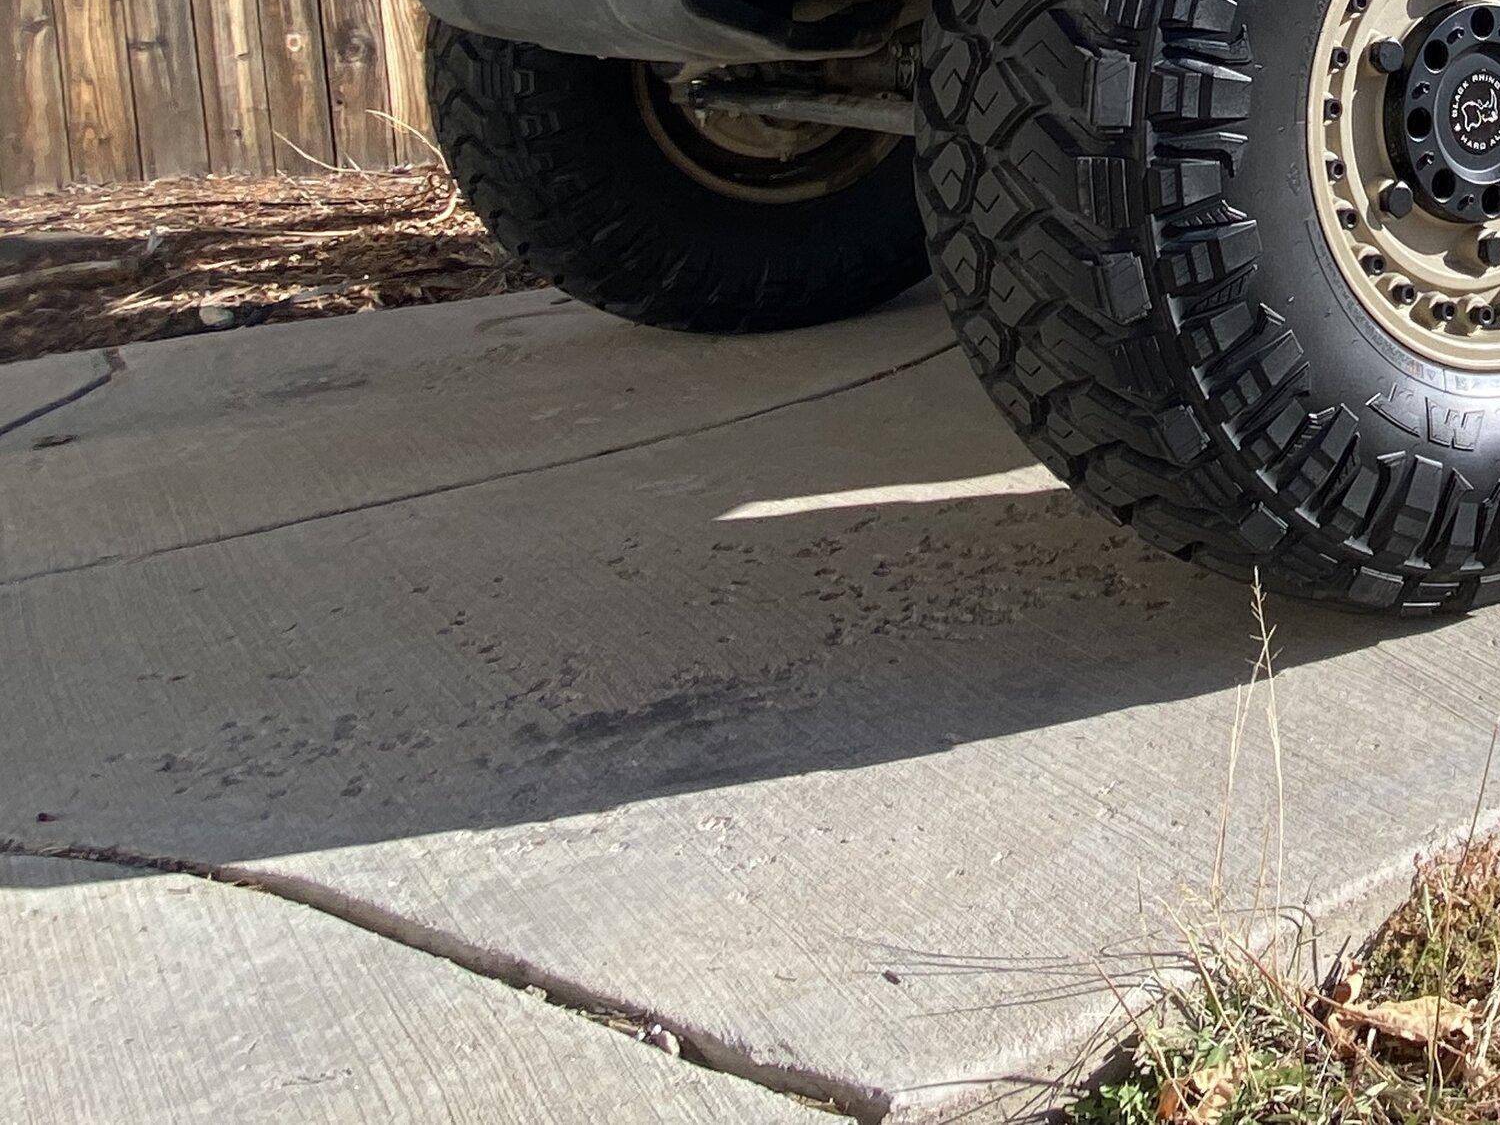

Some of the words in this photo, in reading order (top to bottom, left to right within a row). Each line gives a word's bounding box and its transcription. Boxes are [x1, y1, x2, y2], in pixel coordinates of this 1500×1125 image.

[1451, 80, 1469, 118] BLACK
[1471, 74, 1500, 90] RHINO
[1460, 134, 1487, 150] HARD
